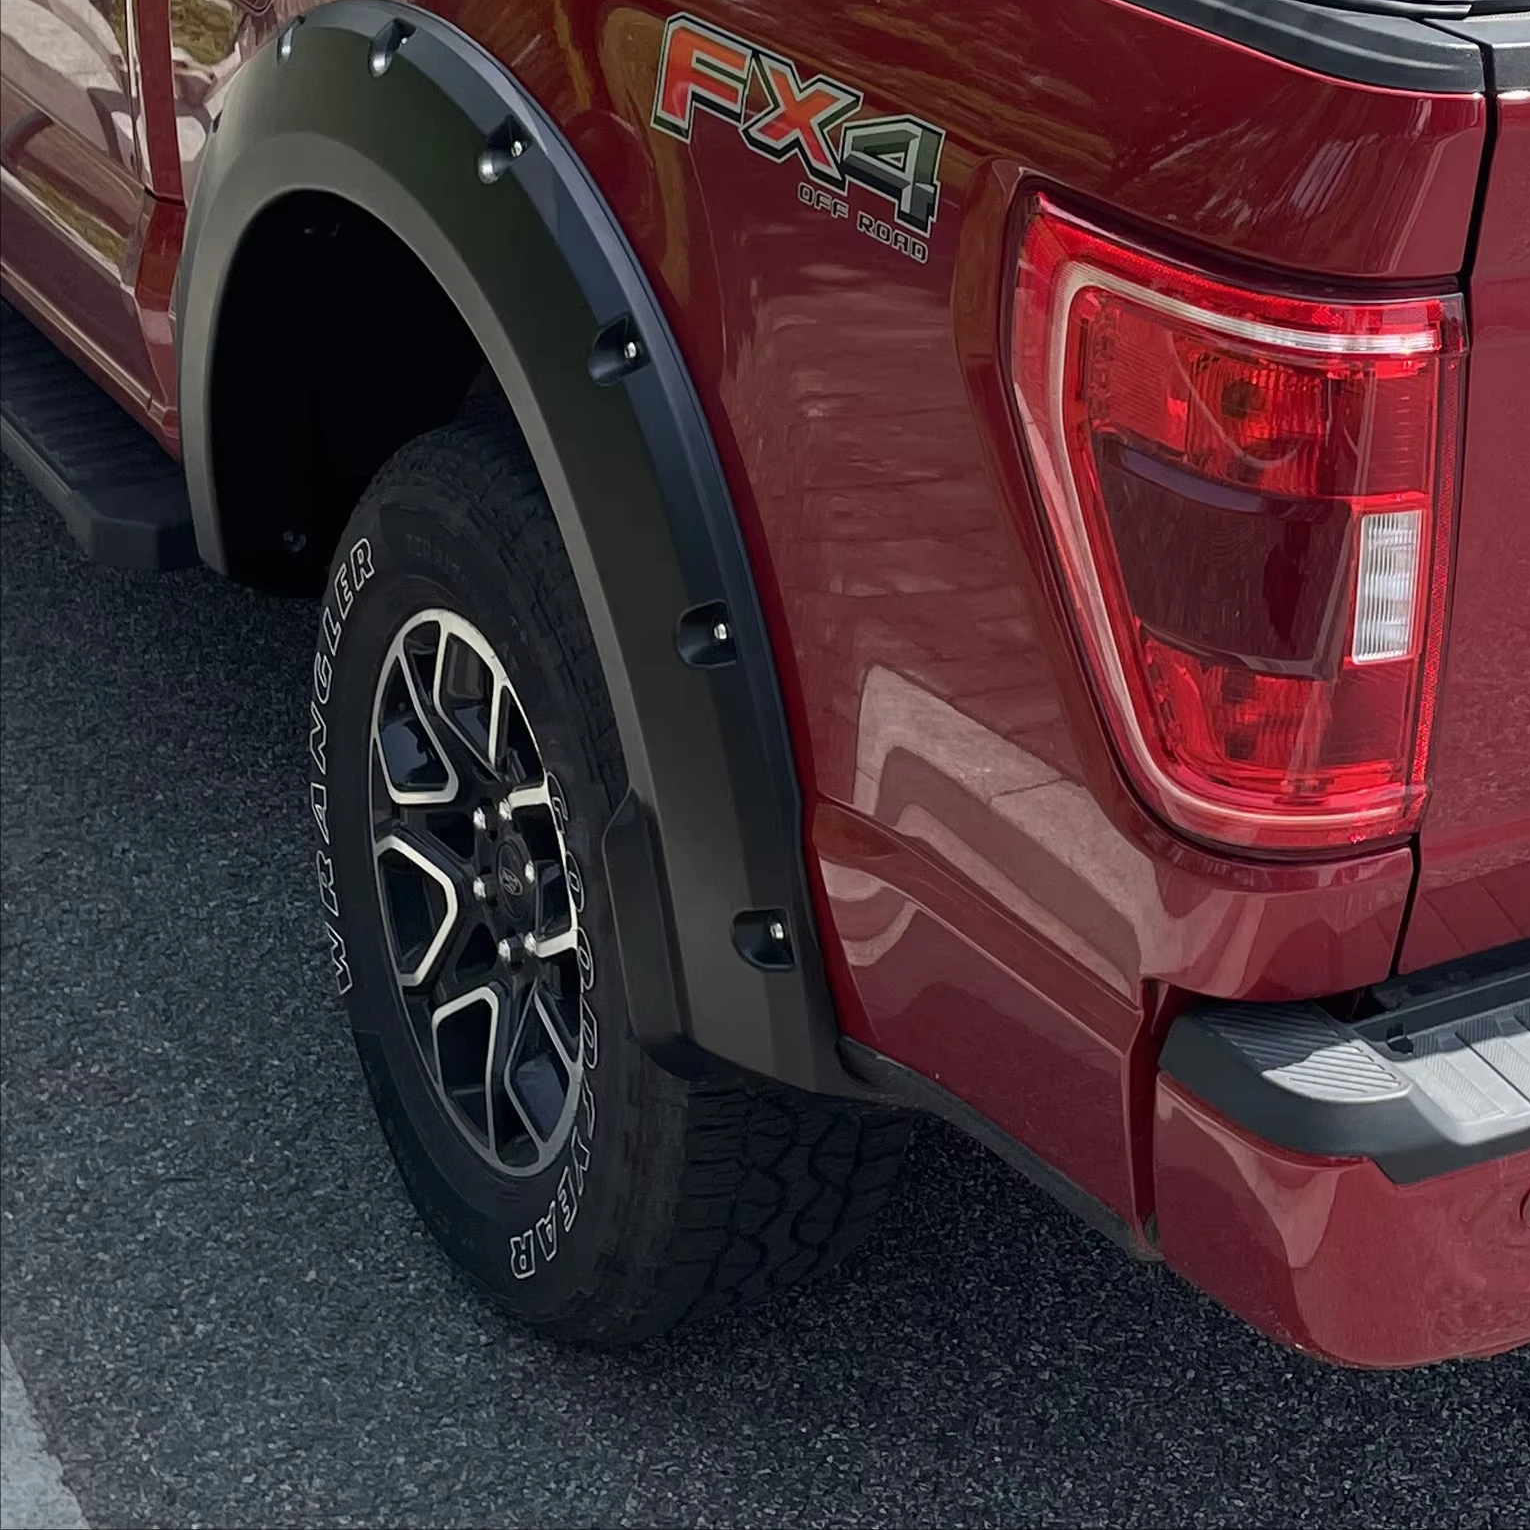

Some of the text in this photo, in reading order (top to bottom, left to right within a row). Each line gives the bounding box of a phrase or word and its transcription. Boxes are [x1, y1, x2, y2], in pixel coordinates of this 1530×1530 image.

[650, 11, 946, 238] FX4
[797, 181, 928, 263] OFF ROAD
[309, 537, 375, 996] WRANGLER
[510, 771, 599, 1279] GOODYEAR
